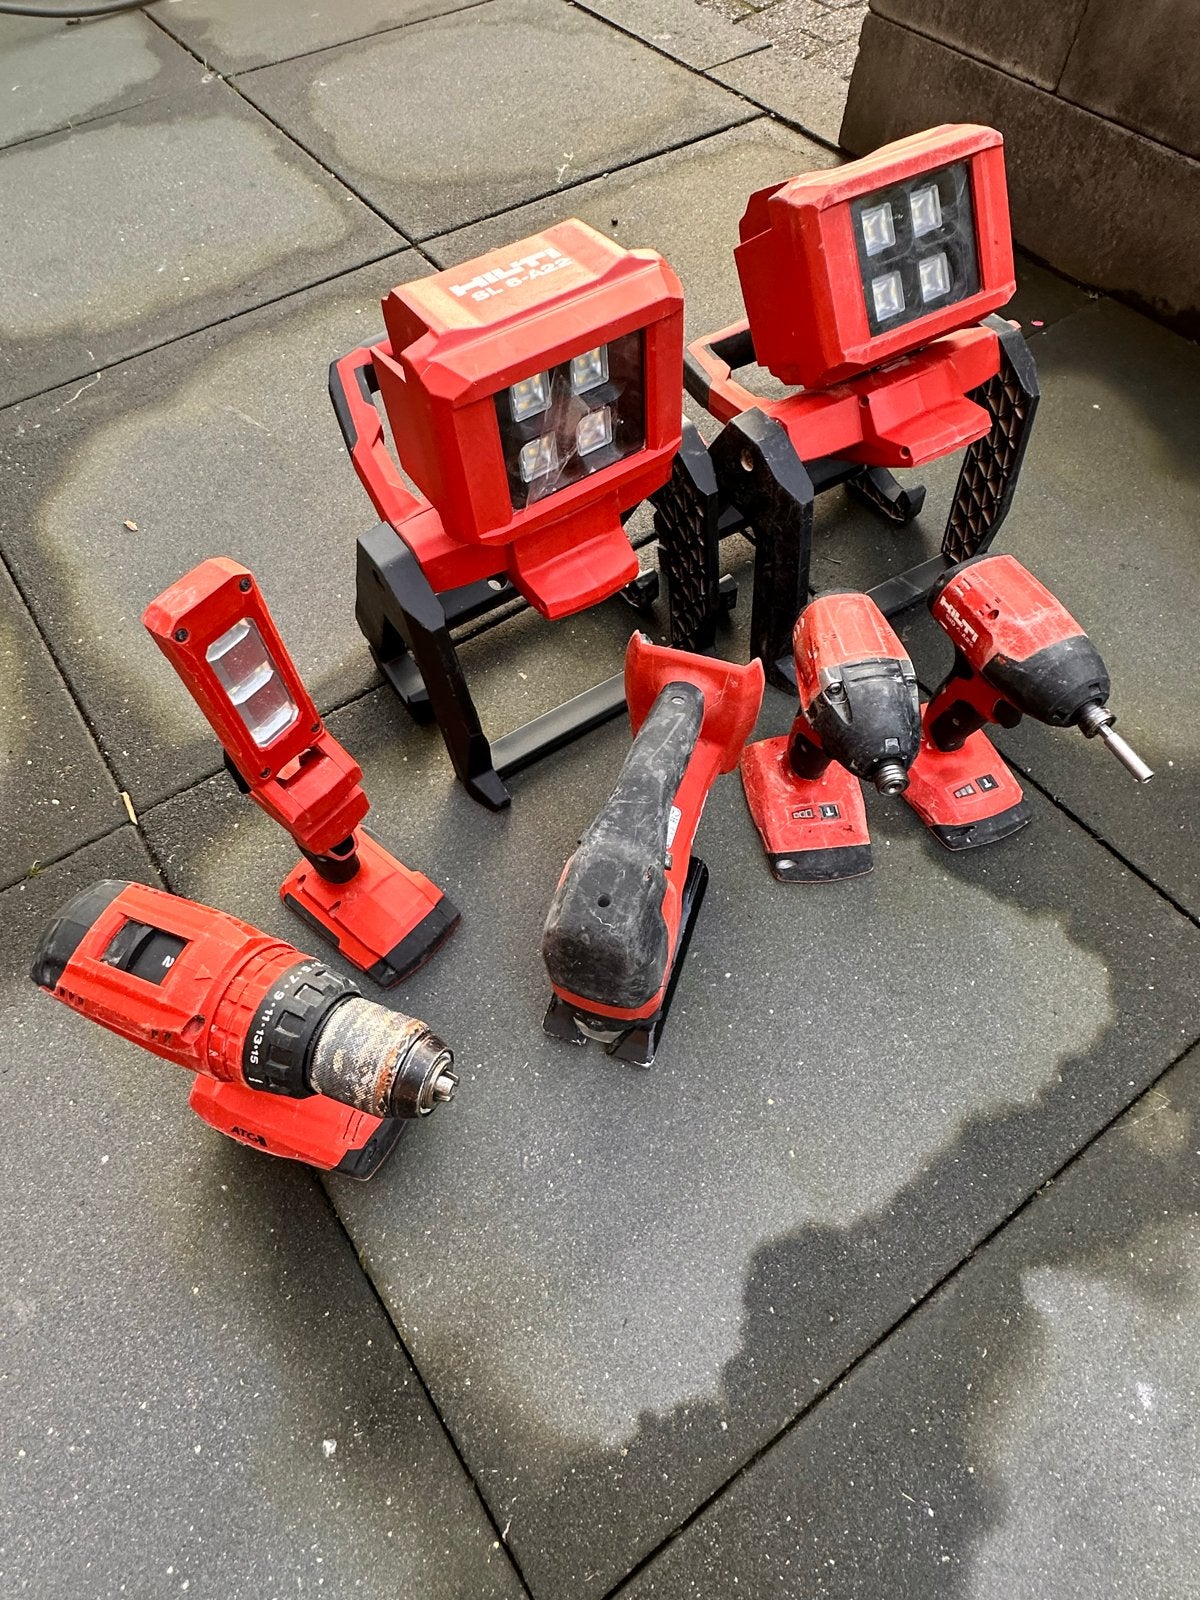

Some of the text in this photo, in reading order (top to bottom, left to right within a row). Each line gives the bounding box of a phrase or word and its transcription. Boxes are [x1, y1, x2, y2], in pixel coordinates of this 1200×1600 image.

[448, 247, 562, 297] HILTI
[471, 257, 573, 302] SL 6-A22
[940, 595, 979, 643] HILTI
[162, 955, 175, 967] 2
